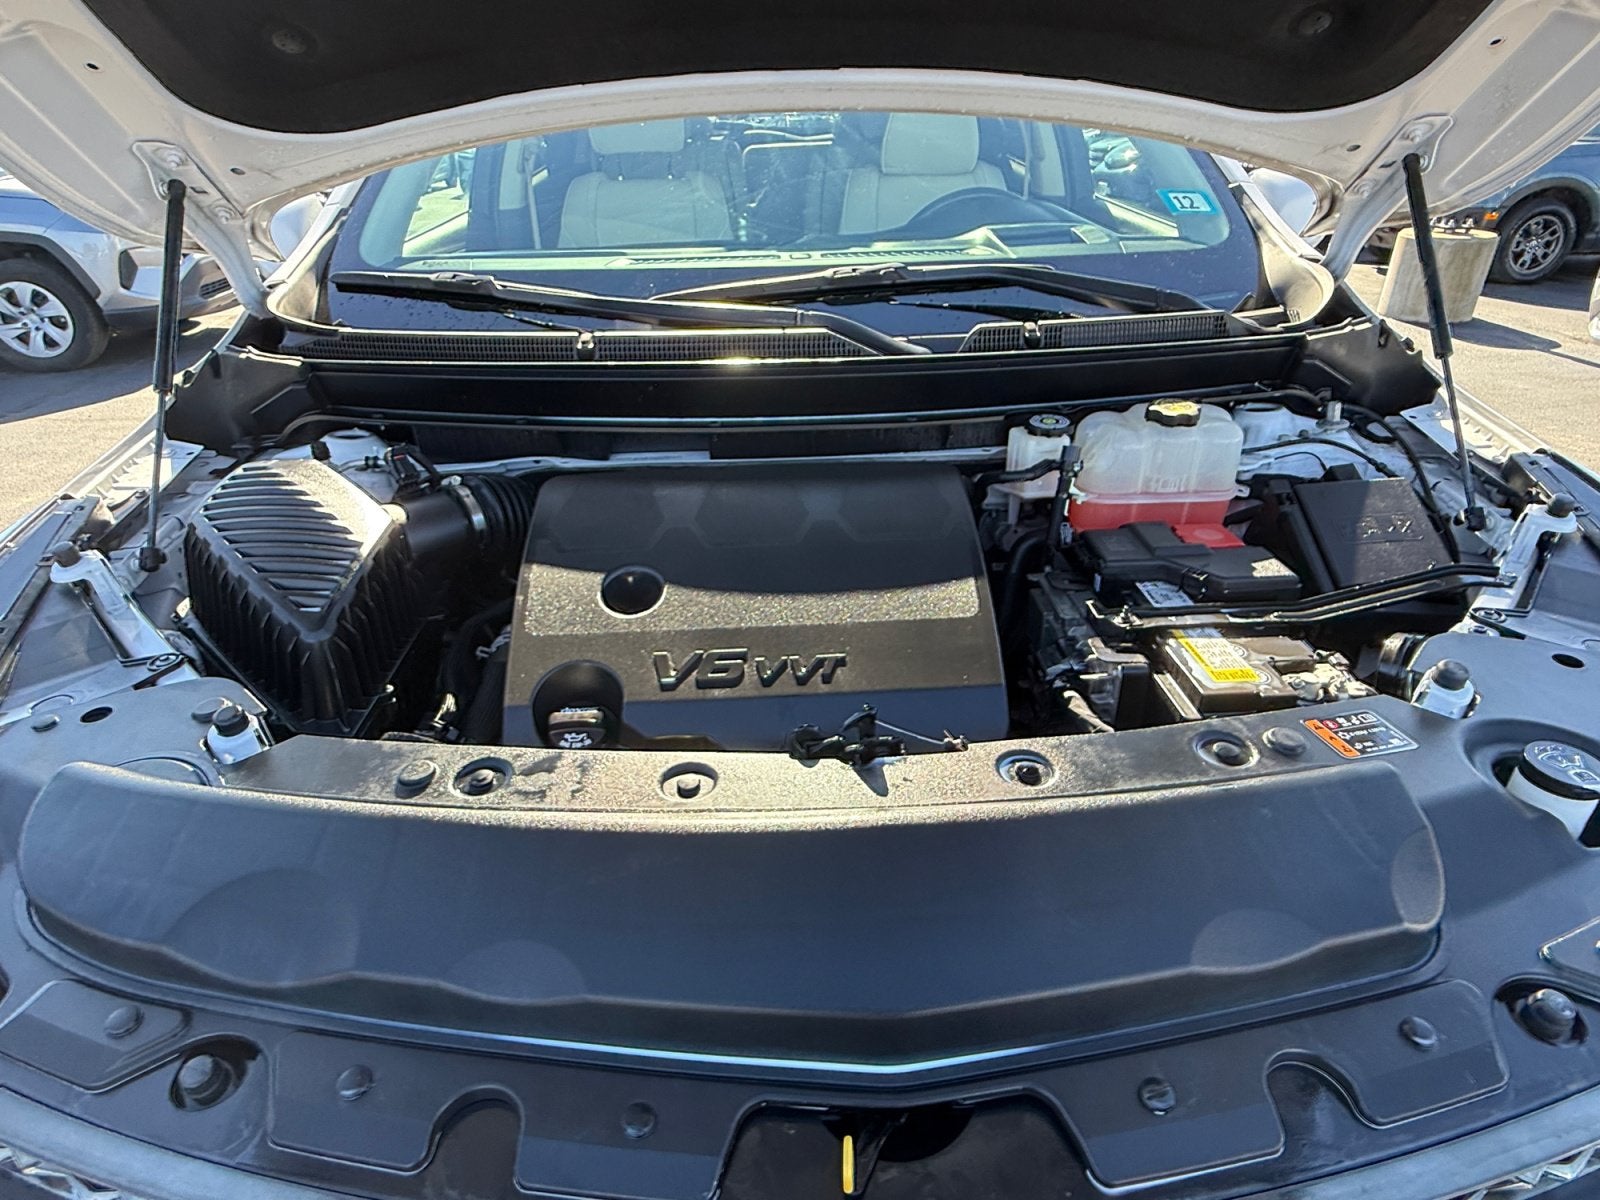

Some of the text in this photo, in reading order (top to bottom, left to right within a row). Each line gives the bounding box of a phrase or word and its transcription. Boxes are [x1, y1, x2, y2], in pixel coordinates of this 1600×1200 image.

[1172, 195, 1200, 210] 12
[653, 648, 847, 691] V6 VVT
